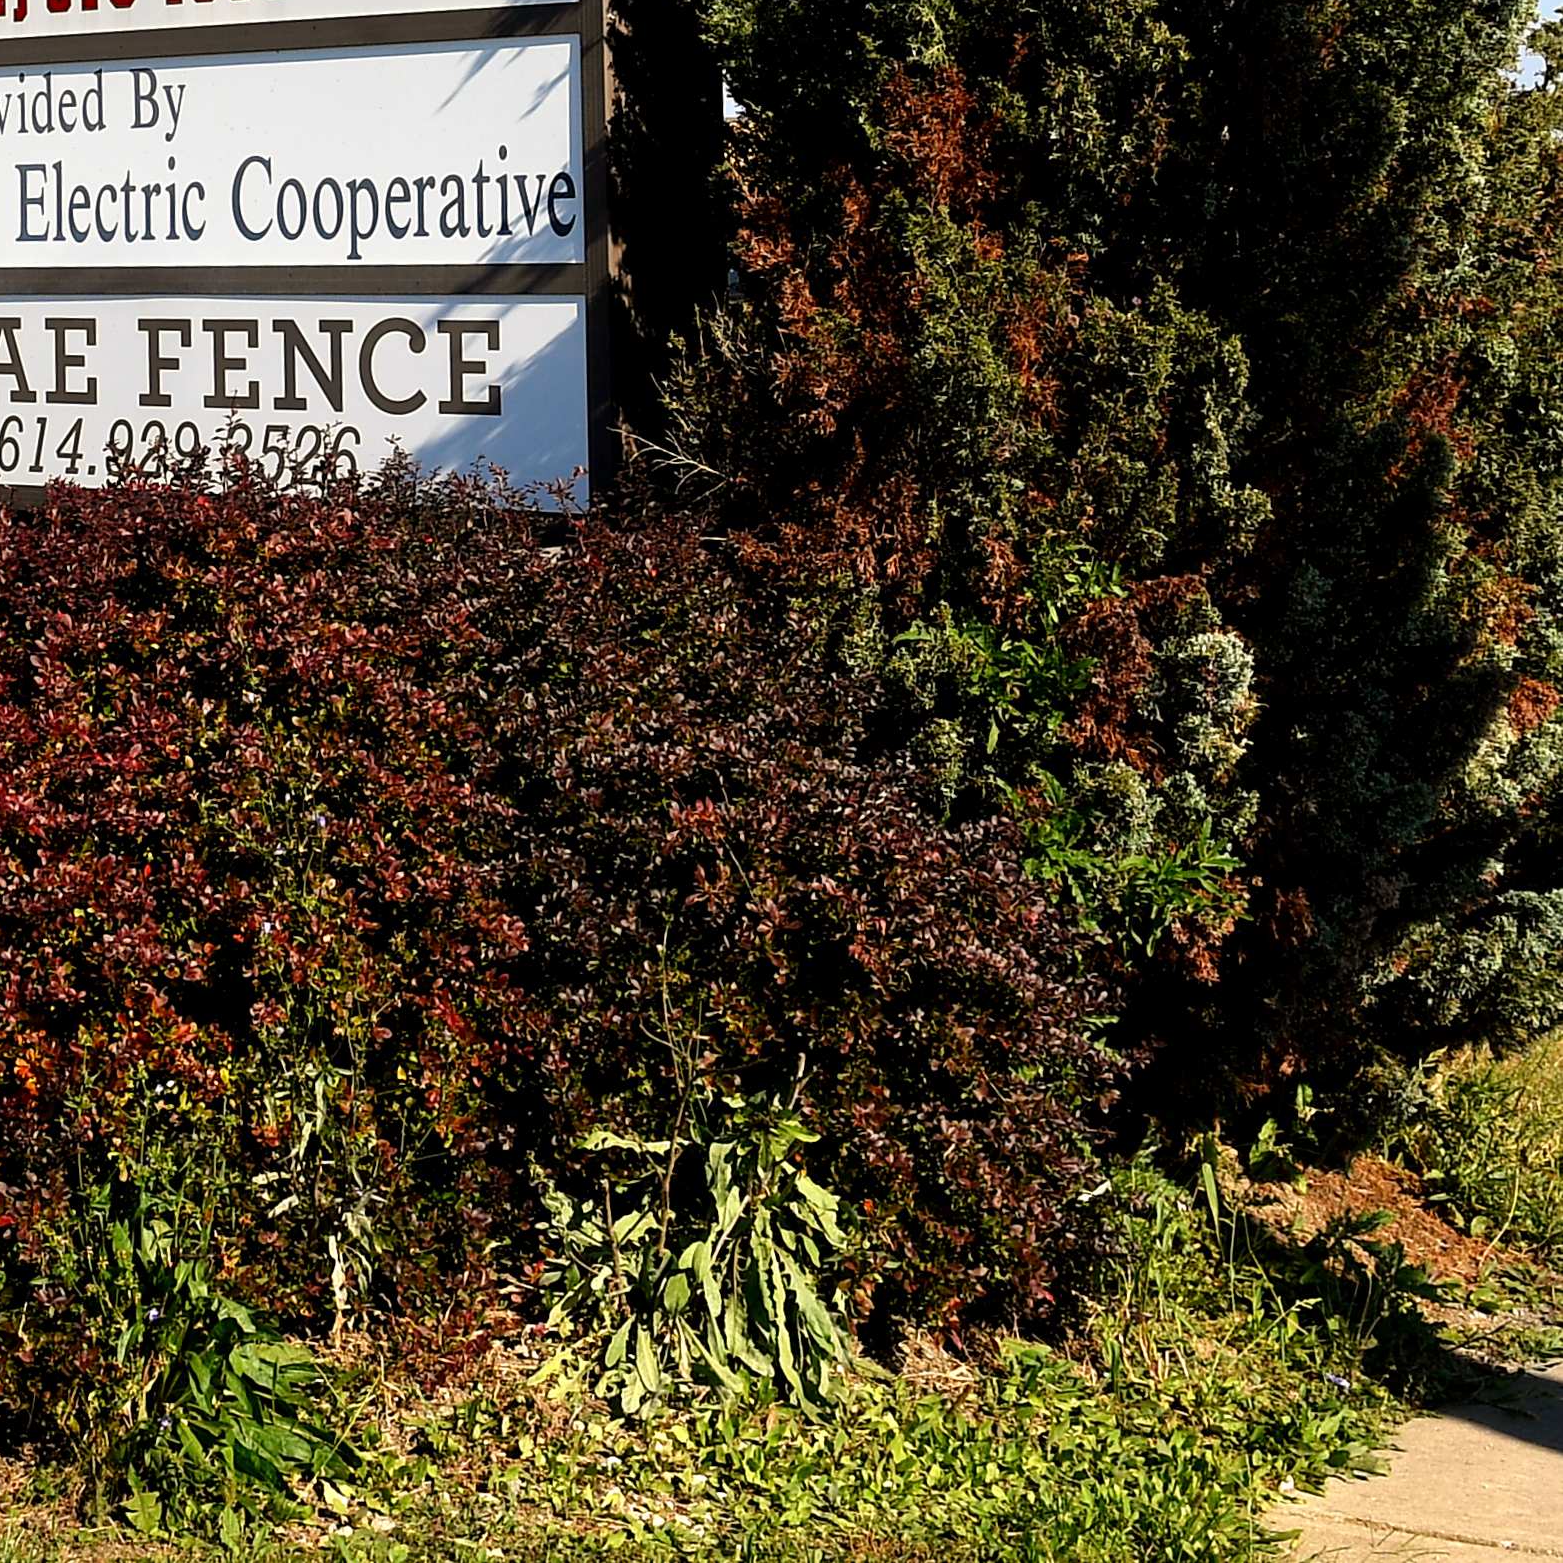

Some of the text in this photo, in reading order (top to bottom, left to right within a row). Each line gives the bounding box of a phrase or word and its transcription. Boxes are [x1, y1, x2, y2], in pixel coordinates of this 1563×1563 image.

[129, 68, 187, 143] By
[16, 156, 206, 243] Electric
[232, 147, 577, 259] Cooperative
[138, 318, 502, 416] FENCE
